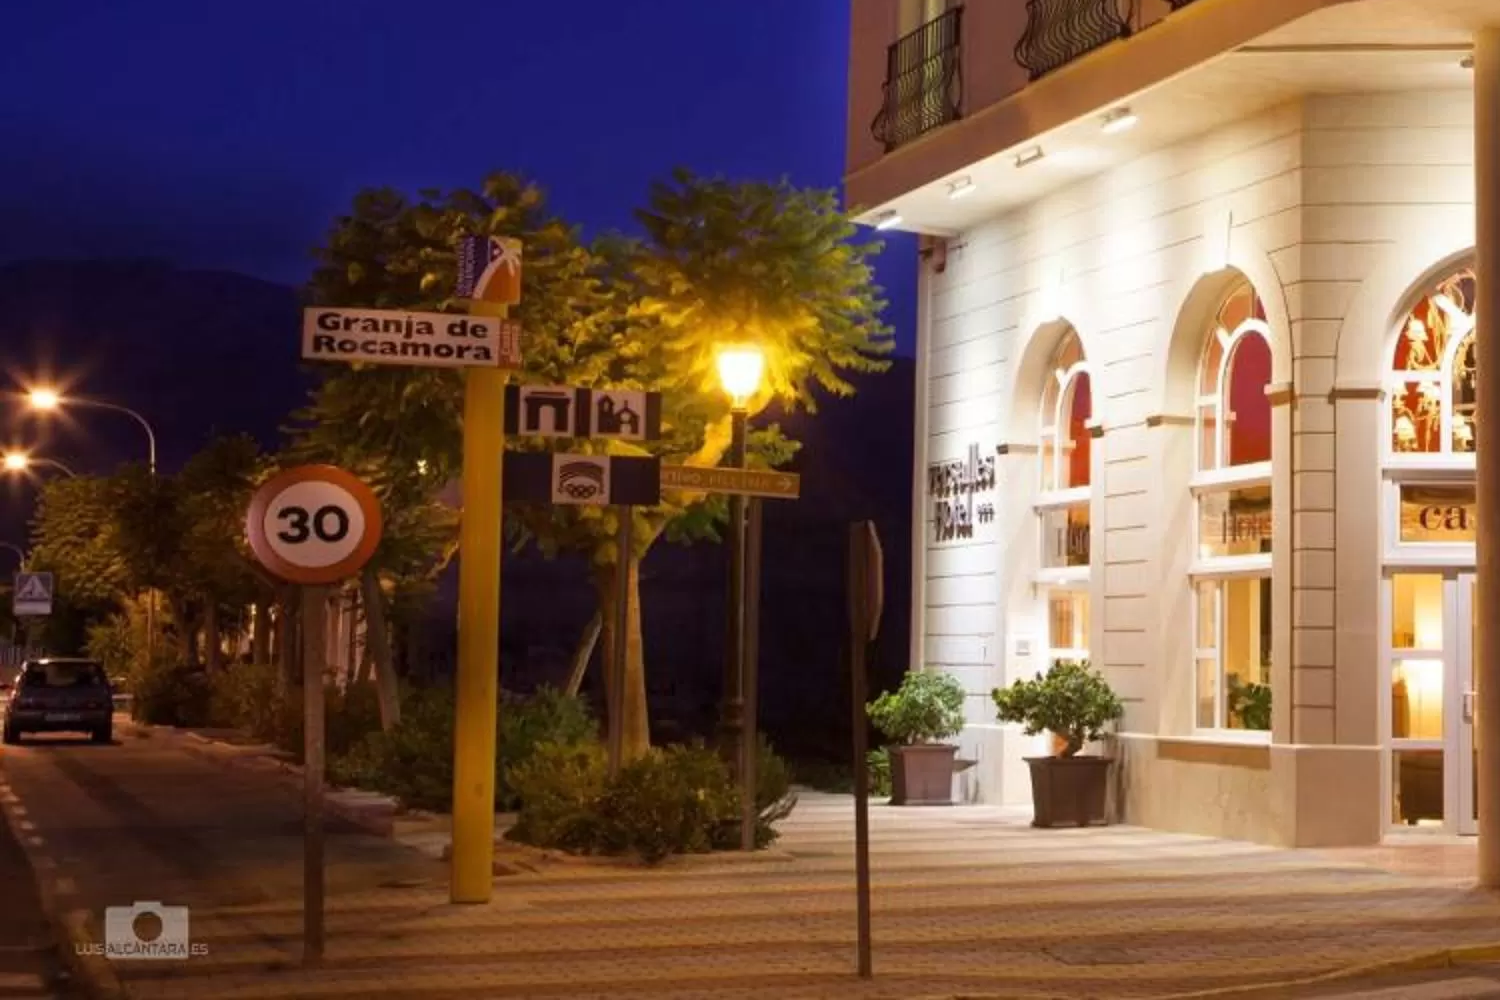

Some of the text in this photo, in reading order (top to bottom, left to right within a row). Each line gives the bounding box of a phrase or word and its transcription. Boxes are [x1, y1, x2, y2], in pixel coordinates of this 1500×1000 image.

[316, 312, 488, 339] Granja de
[312, 335, 492, 360] Rocamora
[277, 505, 349, 544] 30
